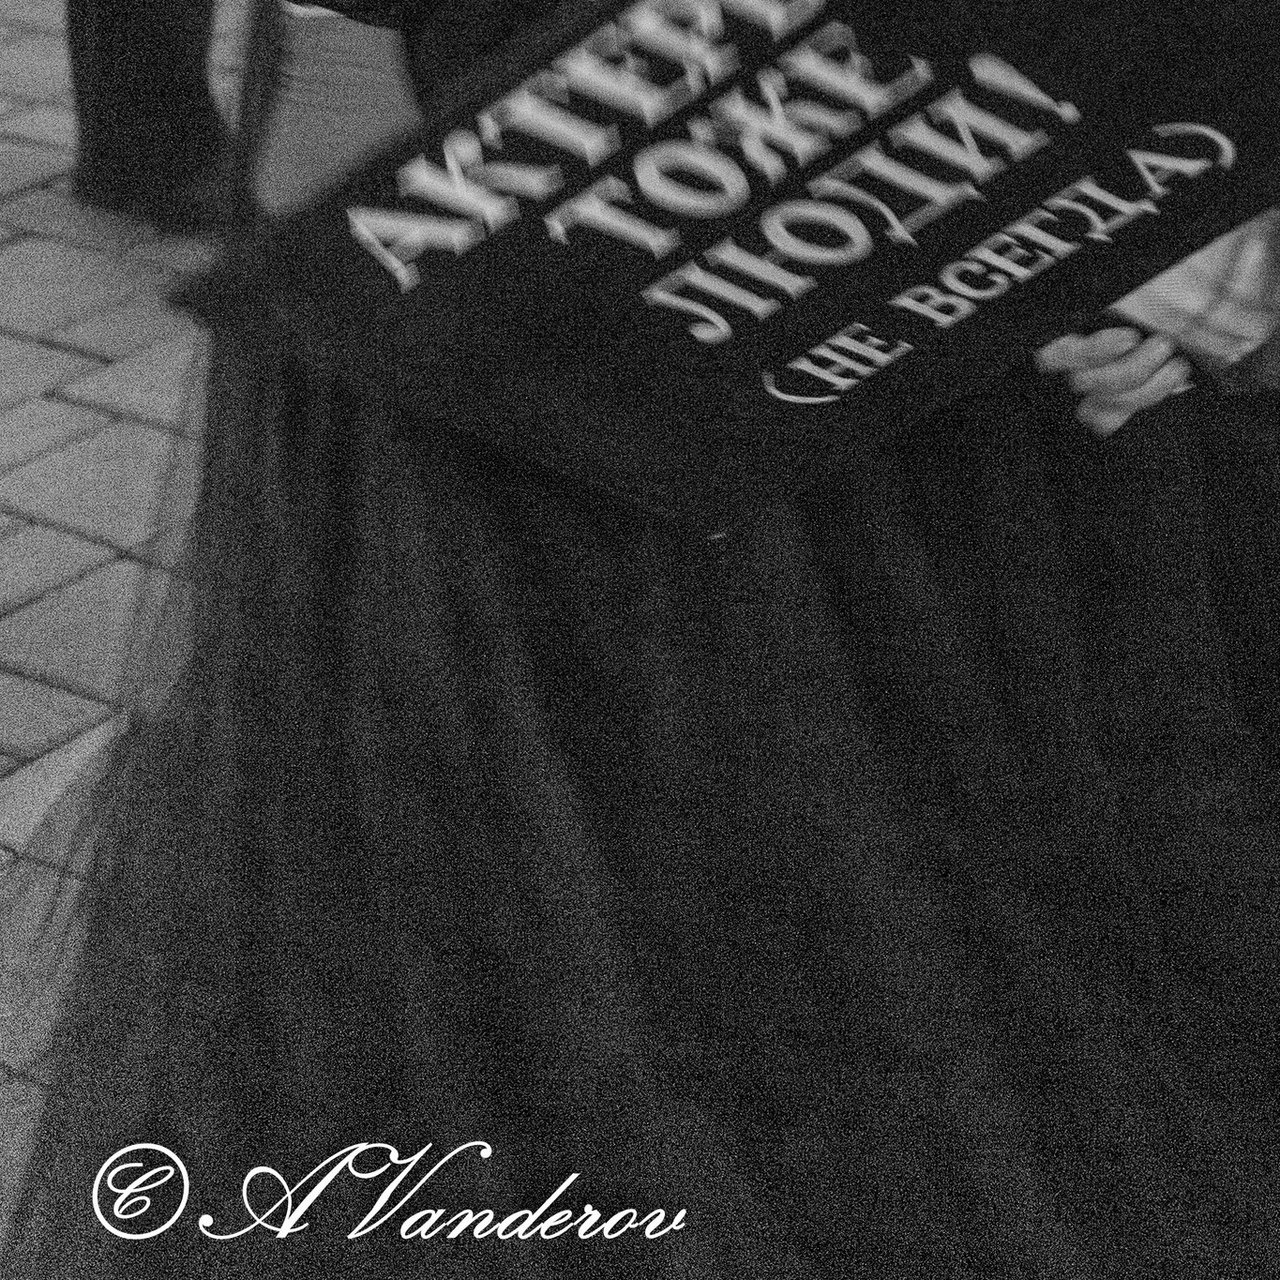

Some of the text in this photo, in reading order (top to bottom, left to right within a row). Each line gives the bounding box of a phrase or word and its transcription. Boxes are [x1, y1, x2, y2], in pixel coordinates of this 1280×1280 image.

[545, 21, 933, 258] ТОЖЕ
[642, 52, 1082, 344] ЛЮДИ!
[762, 122, 1236, 403] (НЕ ВСЕГДА)
